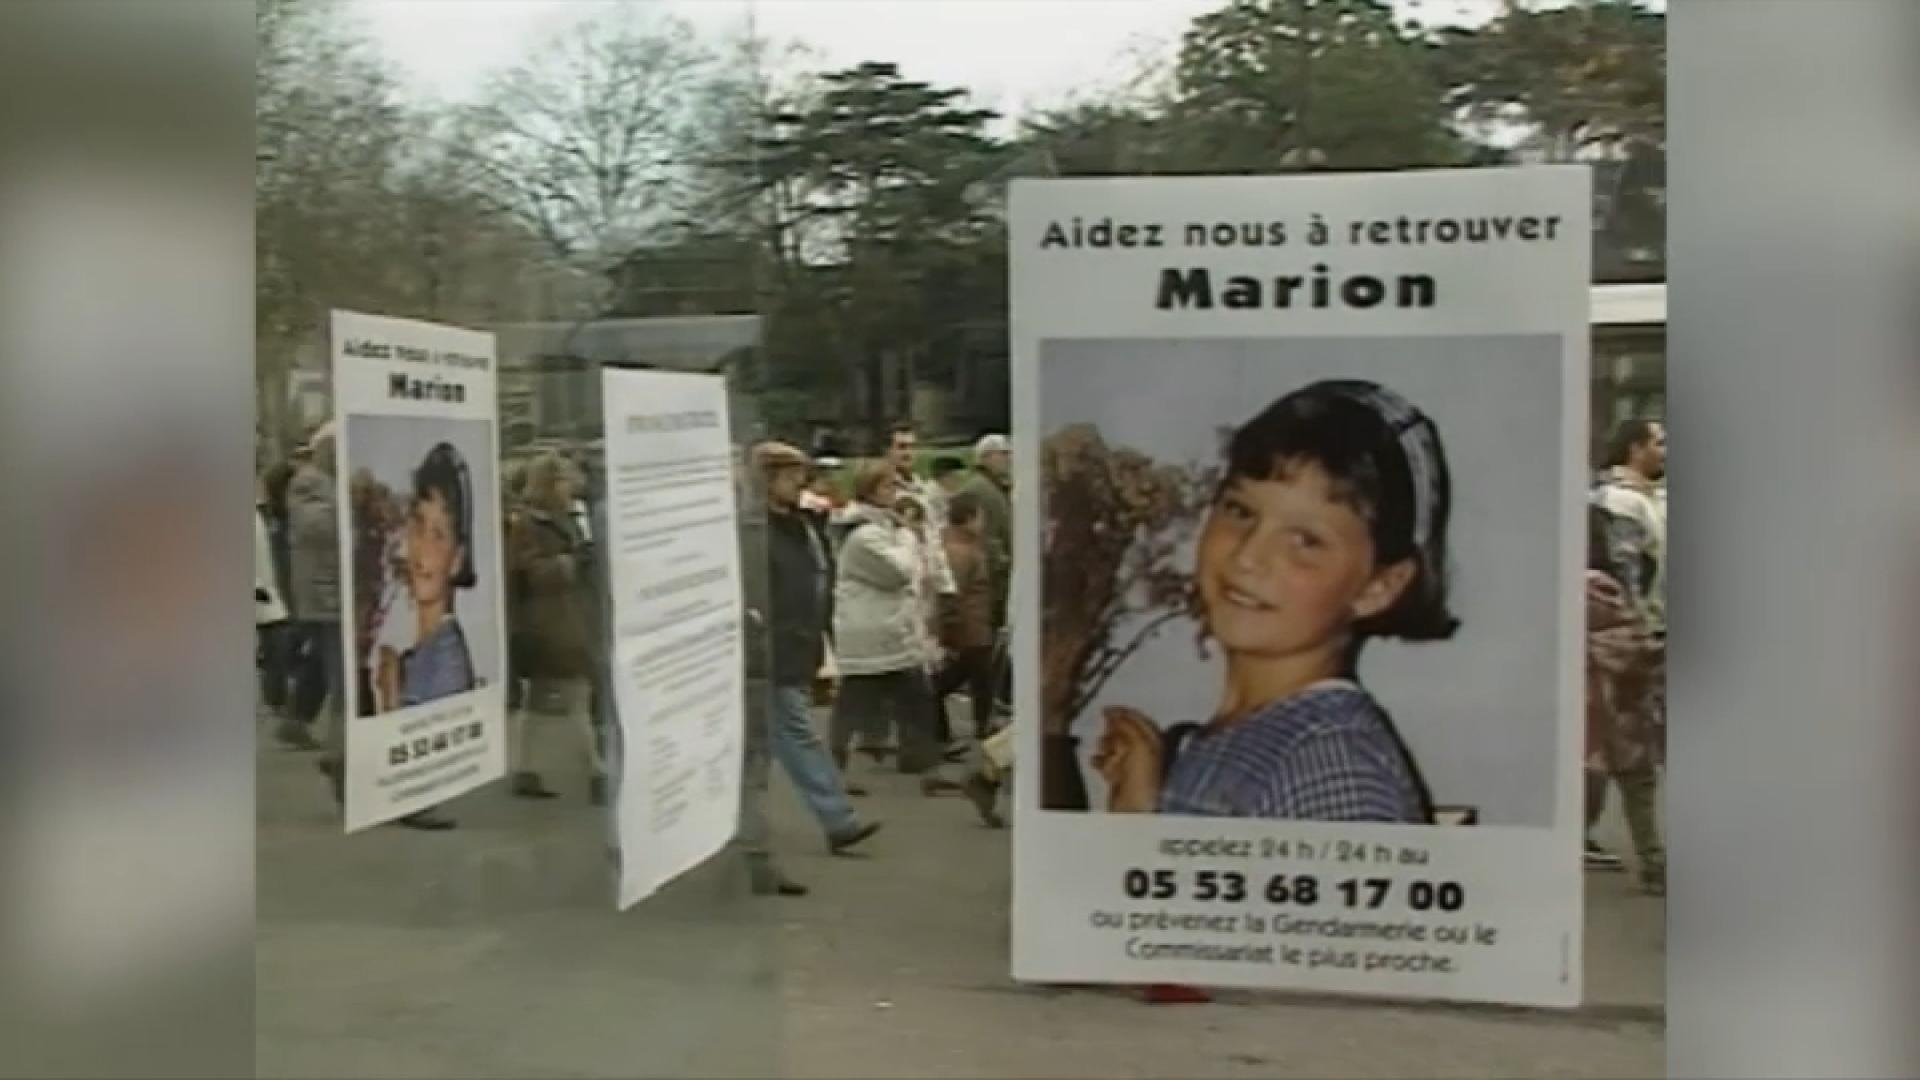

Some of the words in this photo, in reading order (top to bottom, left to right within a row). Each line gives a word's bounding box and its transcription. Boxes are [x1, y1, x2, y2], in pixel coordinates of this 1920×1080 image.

[1040, 216, 1163, 249] Aidez
[1184, 221, 1287, 247] nous
[1307, 213, 1329, 246] à
[1350, 214, 1561, 245] retrouver
[1156, 263, 1436, 309] Marion
[388, 373, 466, 403] Marion
[1125, 869, 1177, 899] 05
[1193, 871, 1246, 902] 53
[1264, 874, 1319, 905] 68
[1336, 878, 1392, 909] 17
[1408, 881, 1464, 911] 00
[1434, 926, 1468, 944] ou
[1474, 924, 1497, 945] le
